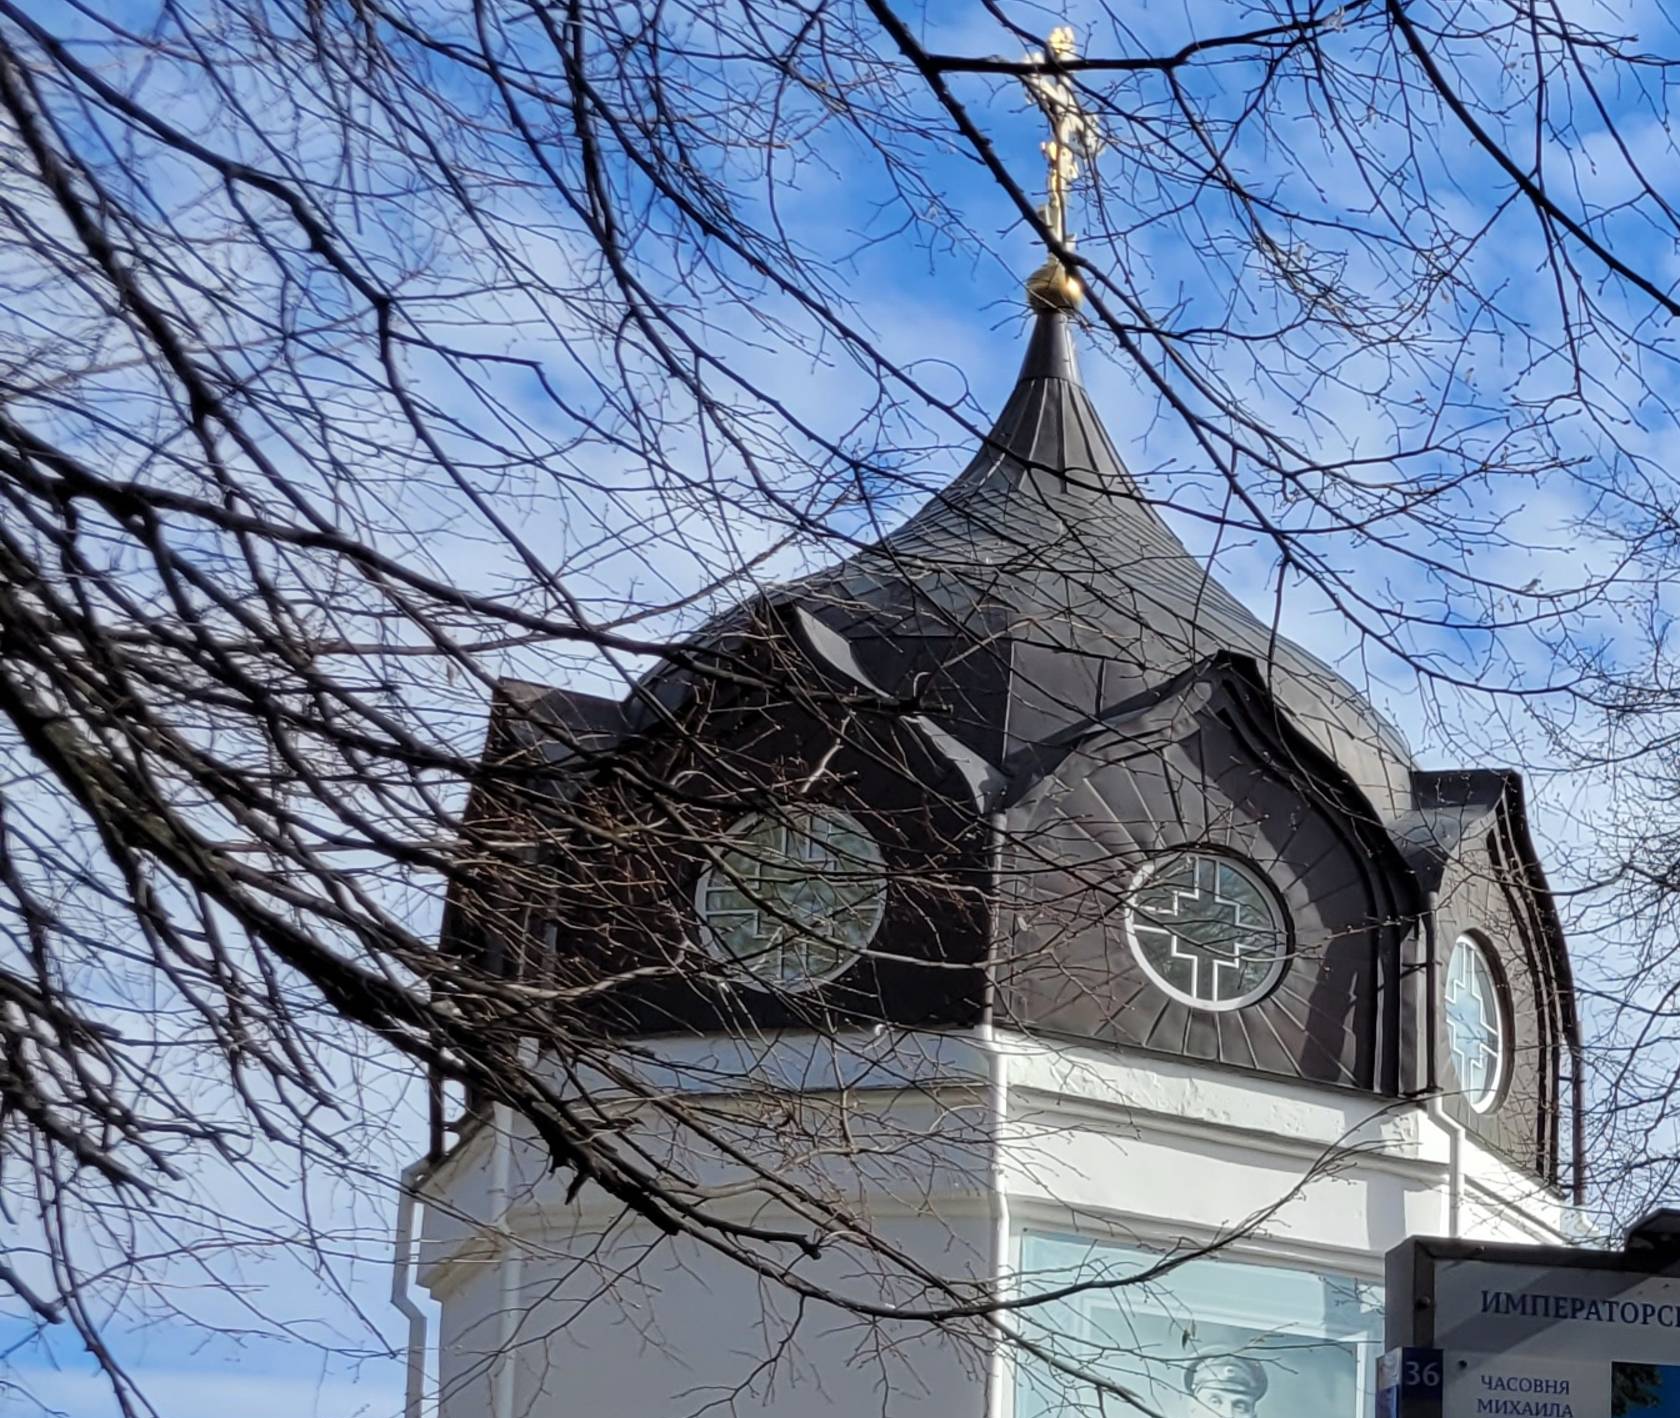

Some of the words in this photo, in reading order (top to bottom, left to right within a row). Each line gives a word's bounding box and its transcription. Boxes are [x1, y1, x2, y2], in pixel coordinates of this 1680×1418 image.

[1405, 1361, 1440, 1386] 36
[1480, 1375, 1570, 1395] ЧАСОВНЯ
[1477, 1398, 1574, 1418] МИХАИЛА
